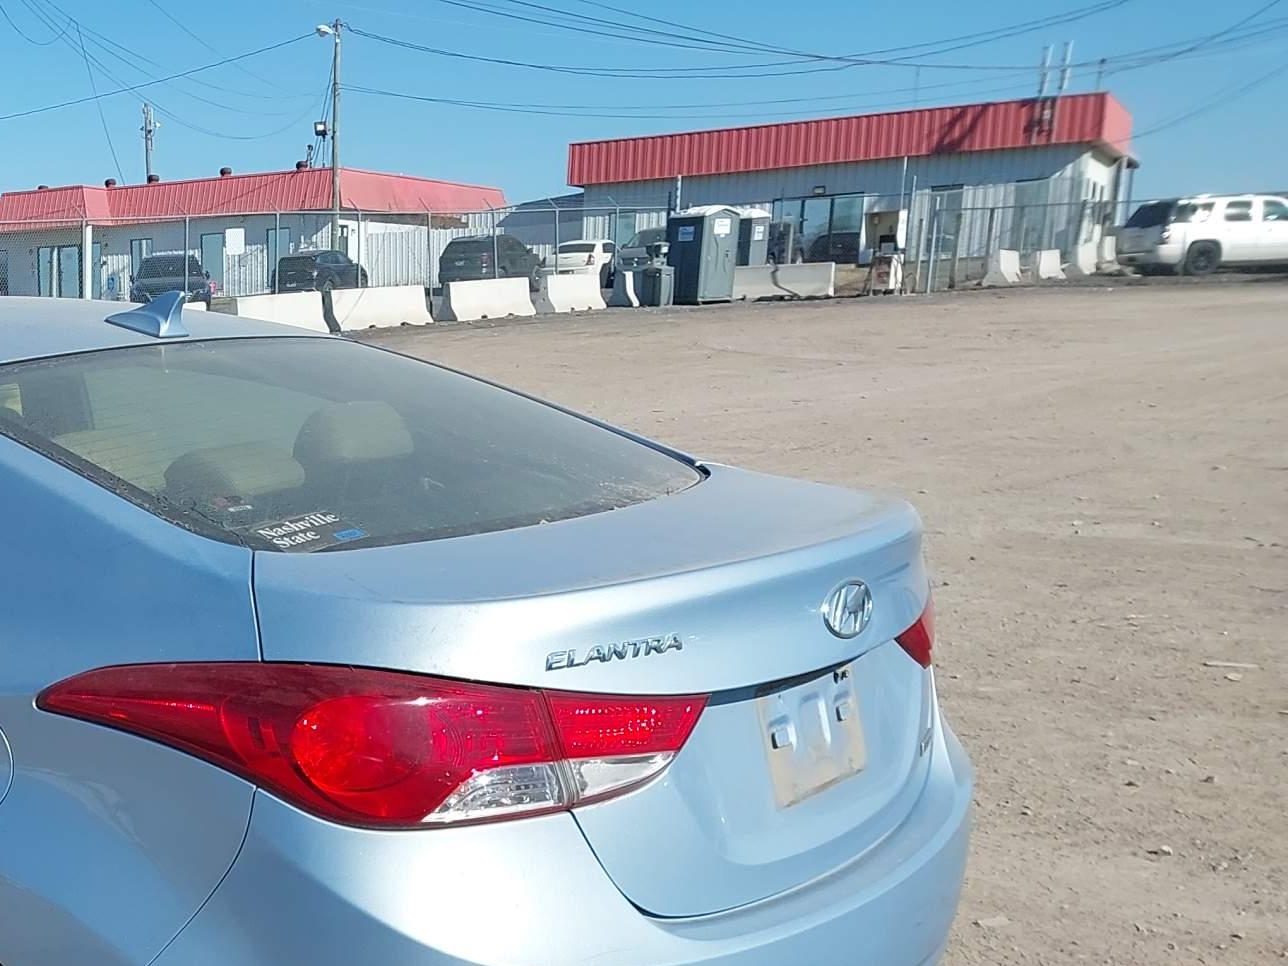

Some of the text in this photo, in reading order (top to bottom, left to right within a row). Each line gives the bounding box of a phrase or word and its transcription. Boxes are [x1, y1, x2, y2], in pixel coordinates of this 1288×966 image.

[257, 513, 340, 539] Nashville
[272, 530, 321, 548] State
[545, 632, 683, 671] ELANTRA
